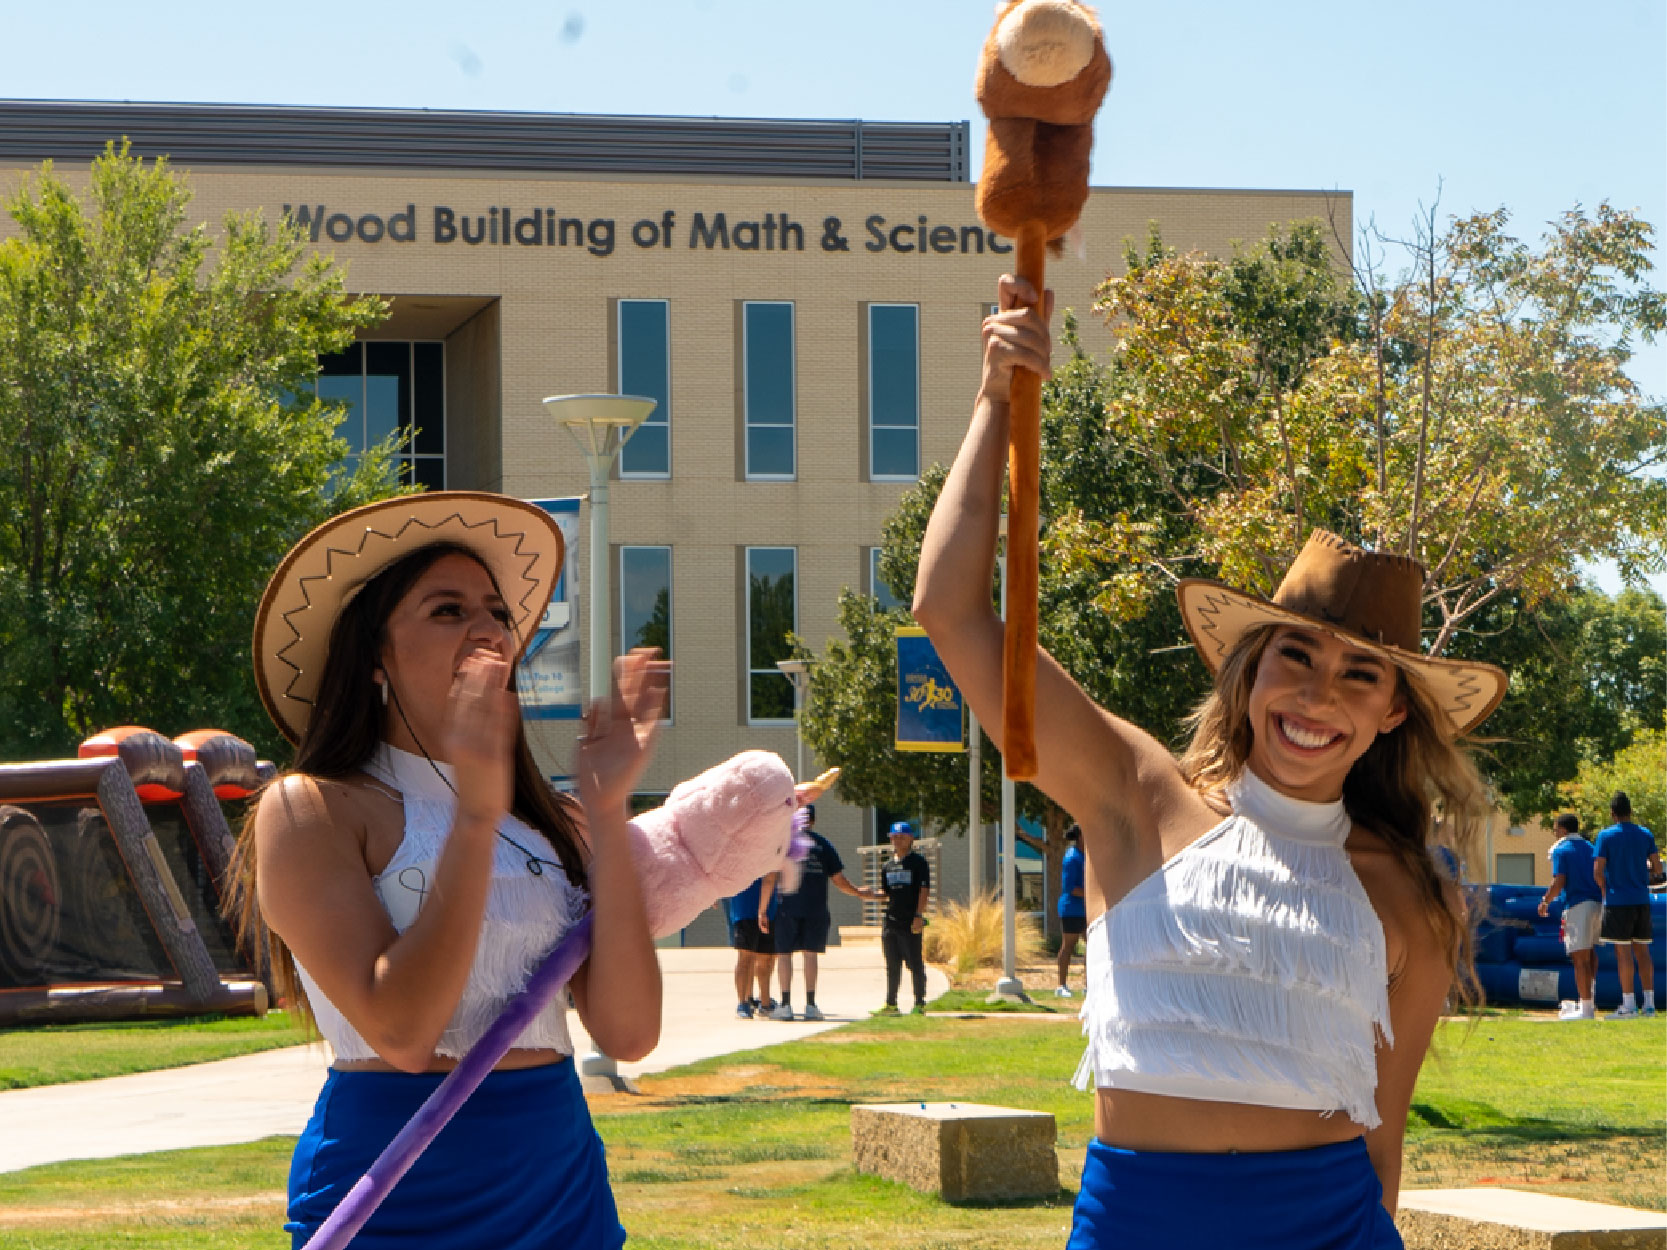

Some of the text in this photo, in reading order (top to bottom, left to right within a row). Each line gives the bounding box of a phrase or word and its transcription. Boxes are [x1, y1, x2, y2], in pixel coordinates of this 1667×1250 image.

[283, 203, 1014, 257] Wood Building of Math & Scienc
